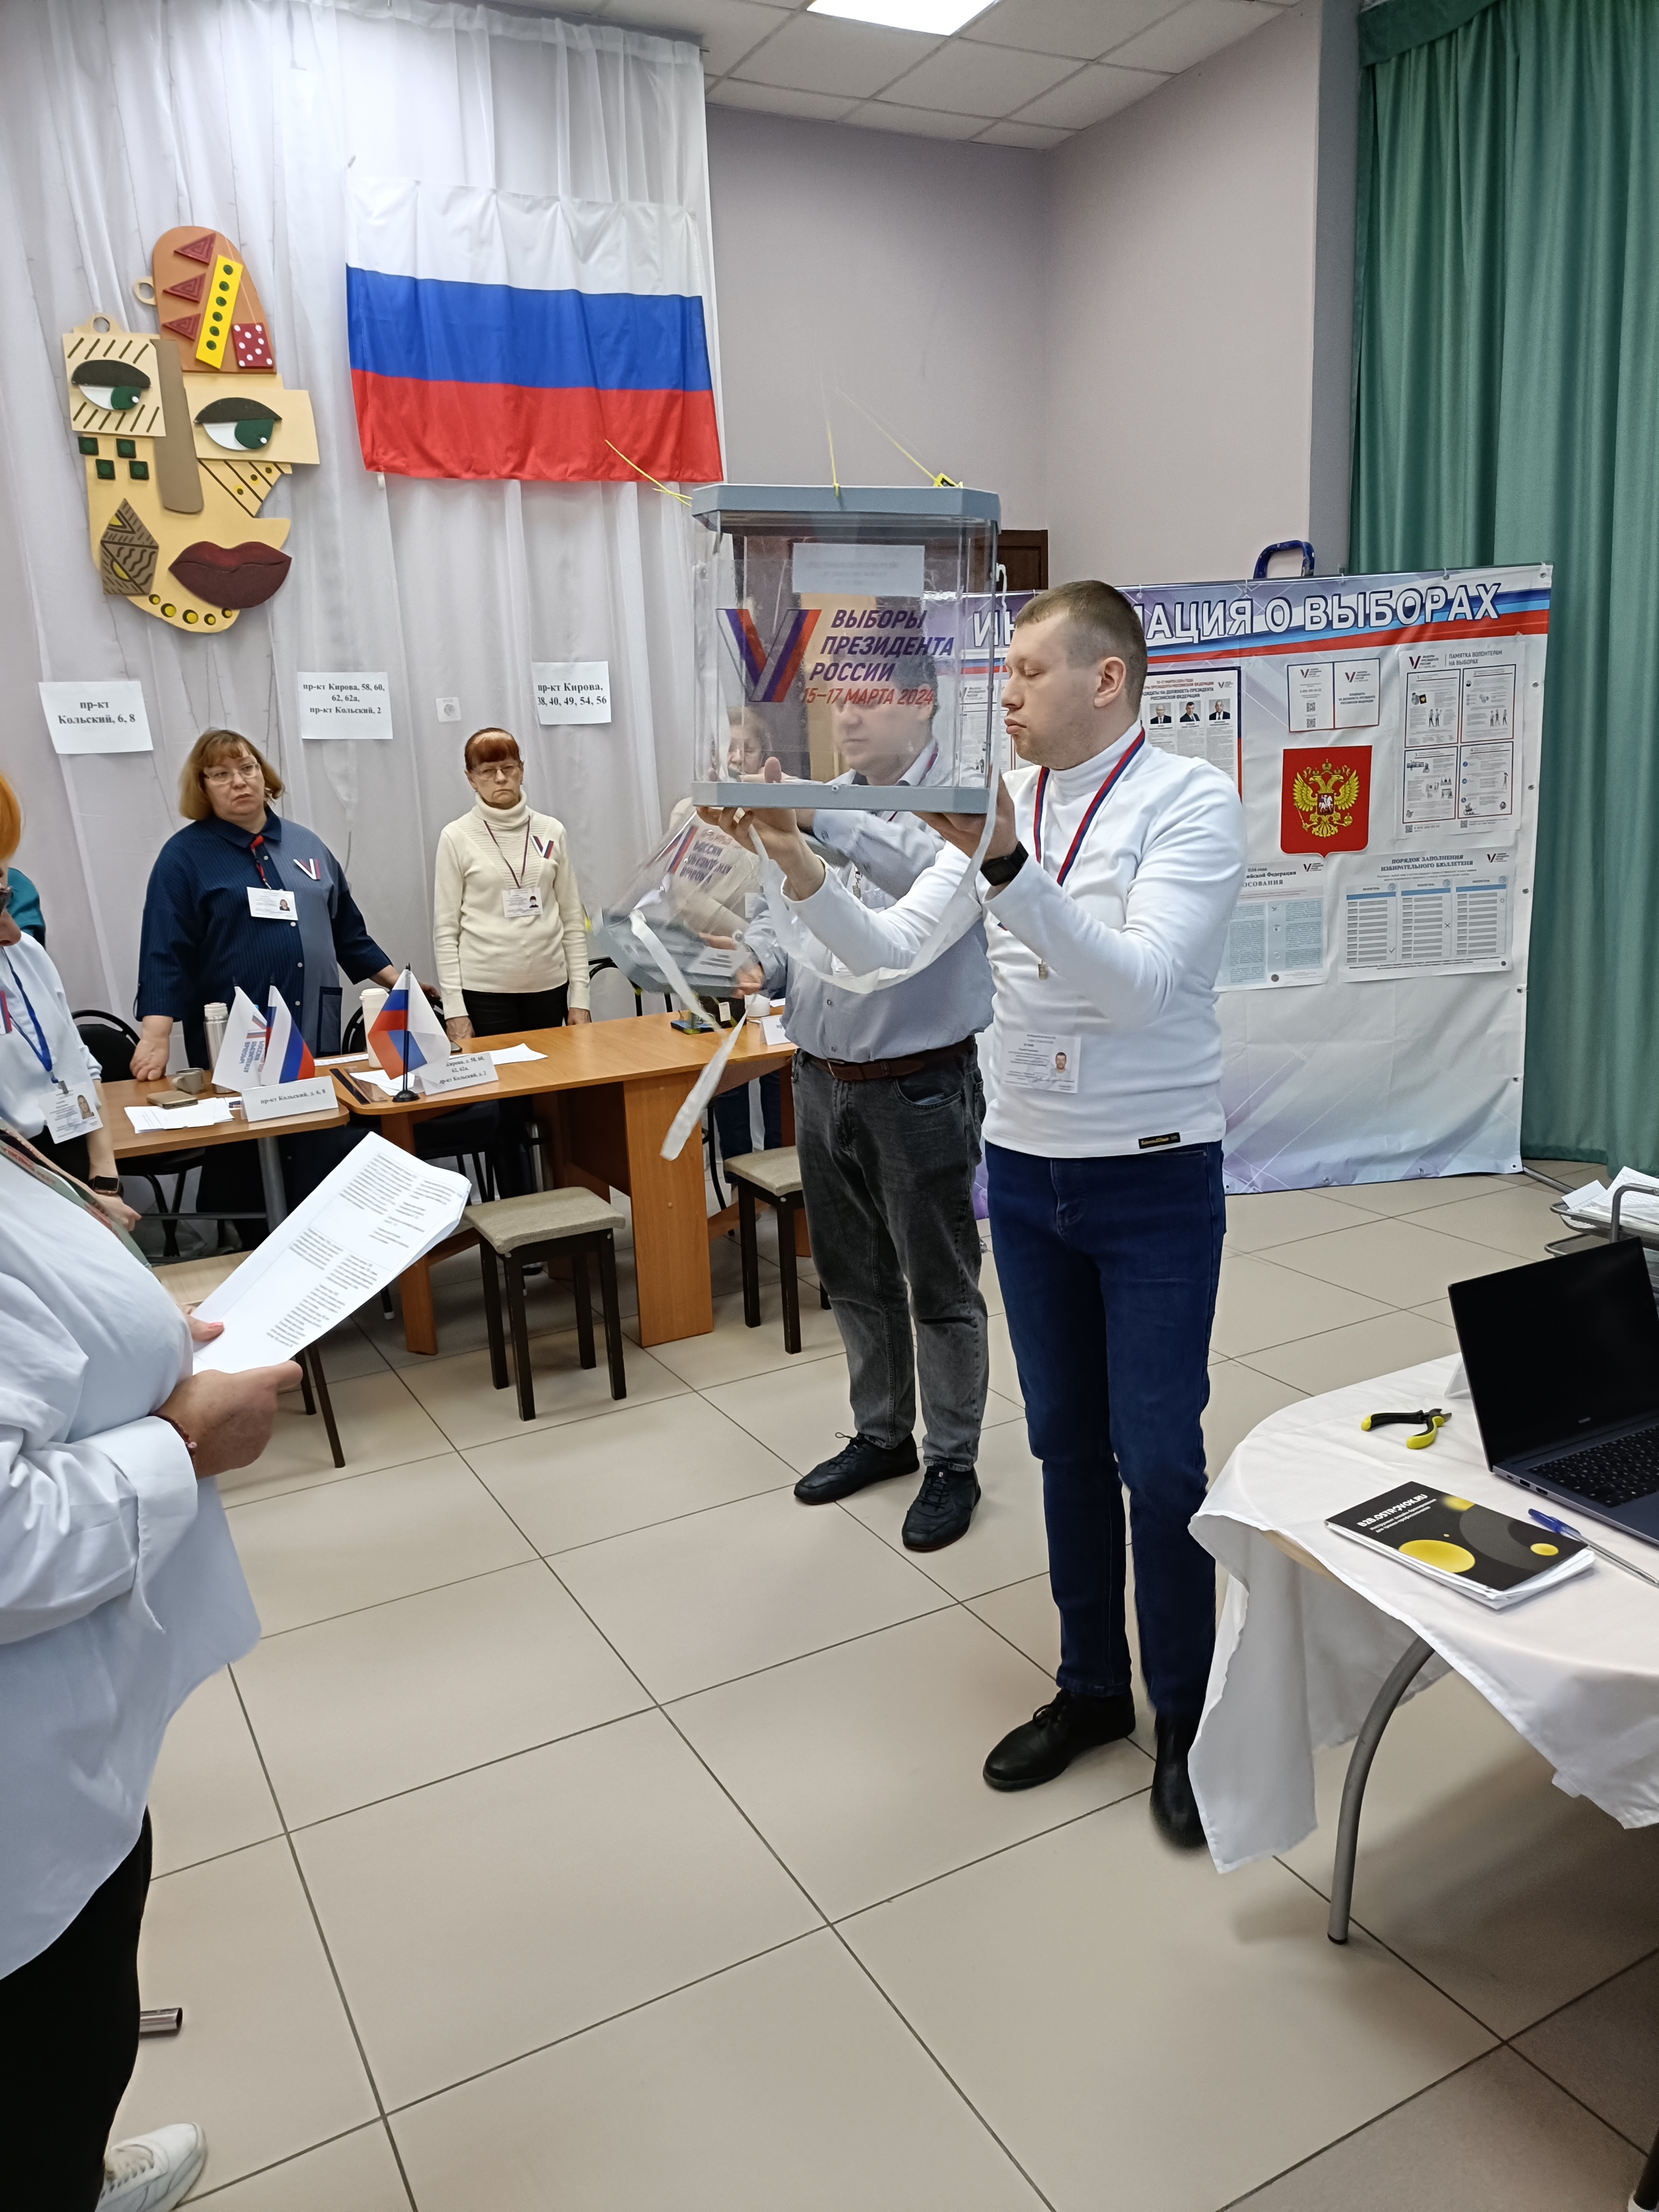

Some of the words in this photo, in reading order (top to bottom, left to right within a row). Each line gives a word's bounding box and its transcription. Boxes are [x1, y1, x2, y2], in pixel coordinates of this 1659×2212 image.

[831, 609, 928, 629] ВЫБОРЫ
[973, 597, 1253, 648] ИНАЦИЯ
[1263, 595, 1293, 634] О
[1303, 582, 1501, 631] ВЫБОРАХ
[820, 636, 955, 658] ПРЕЗИДЕНТА
[809, 662, 896, 682] РОССИИ
[329, 683, 360, 692] Кирова,
[538, 684, 561, 693] пр-кт
[564, 683, 603, 693] Кирова,
[332, 694, 343, 702] 62,
[344, 694, 360, 702] 62а,
[549, 697, 562, 707] 40,
[564, 697, 577, 706] 49,
[580, 696, 593, 706] 54,
[596, 695, 607, 704] 56
[844, 688, 895, 704] МАРТА
[897, 688, 933, 705] 2024
[80, 702, 110, 711] пр-кт
[335, 707, 375, 715] Кольский,
[58, 714, 115, 724] Кольский,
[117, 714, 127, 724] 6,
[129, 714, 135, 722] 8
[1381, 863, 1435, 871] ИЗБИРАТЕЛЬНОГО
[1243, 879, 1283, 887] ОСОВАНИЯ
[278, 1092, 309, 1101] Кольский,
